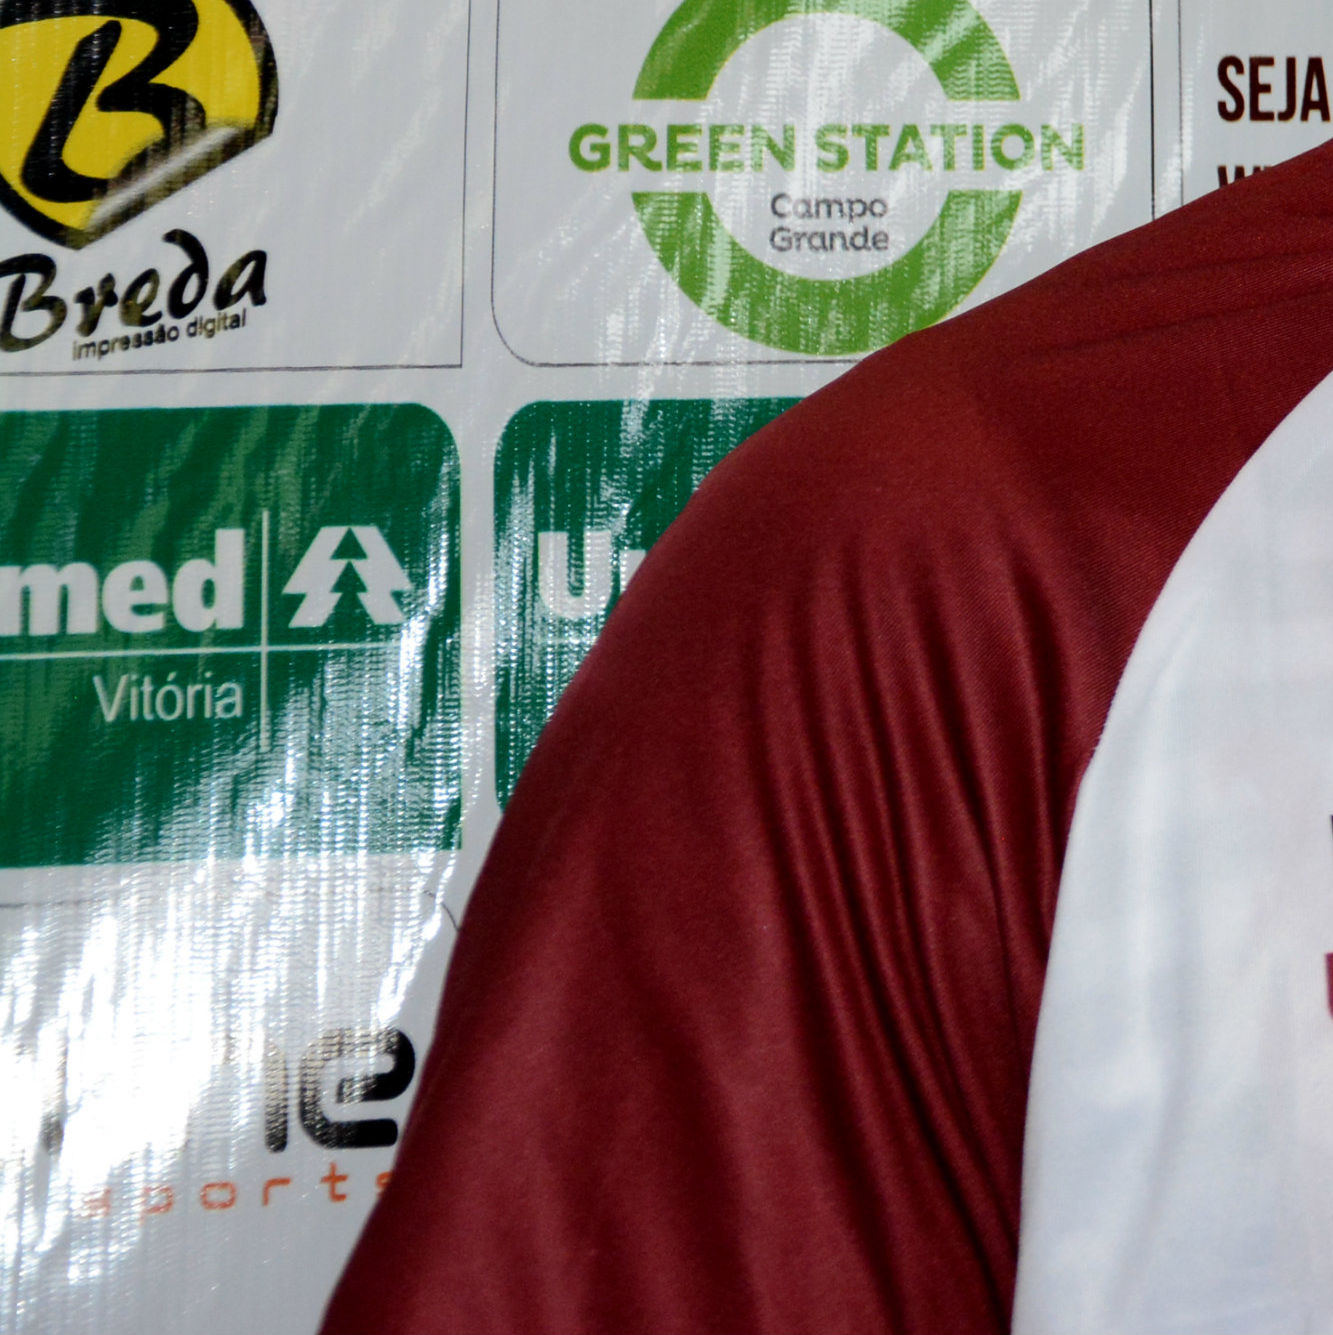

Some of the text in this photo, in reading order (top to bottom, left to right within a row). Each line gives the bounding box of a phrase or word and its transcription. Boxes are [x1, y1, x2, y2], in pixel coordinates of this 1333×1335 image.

[1217, 55, 1331, 122] SEJA
[567, 122, 1085, 175] GREEN STATION
[770, 192, 889, 224] Campo
[770, 224, 890, 254] Grande
[0, 228, 267, 352] Breda
[72, 307, 247, 362] impressão digital
[94, 670, 244, 724] Vitória
